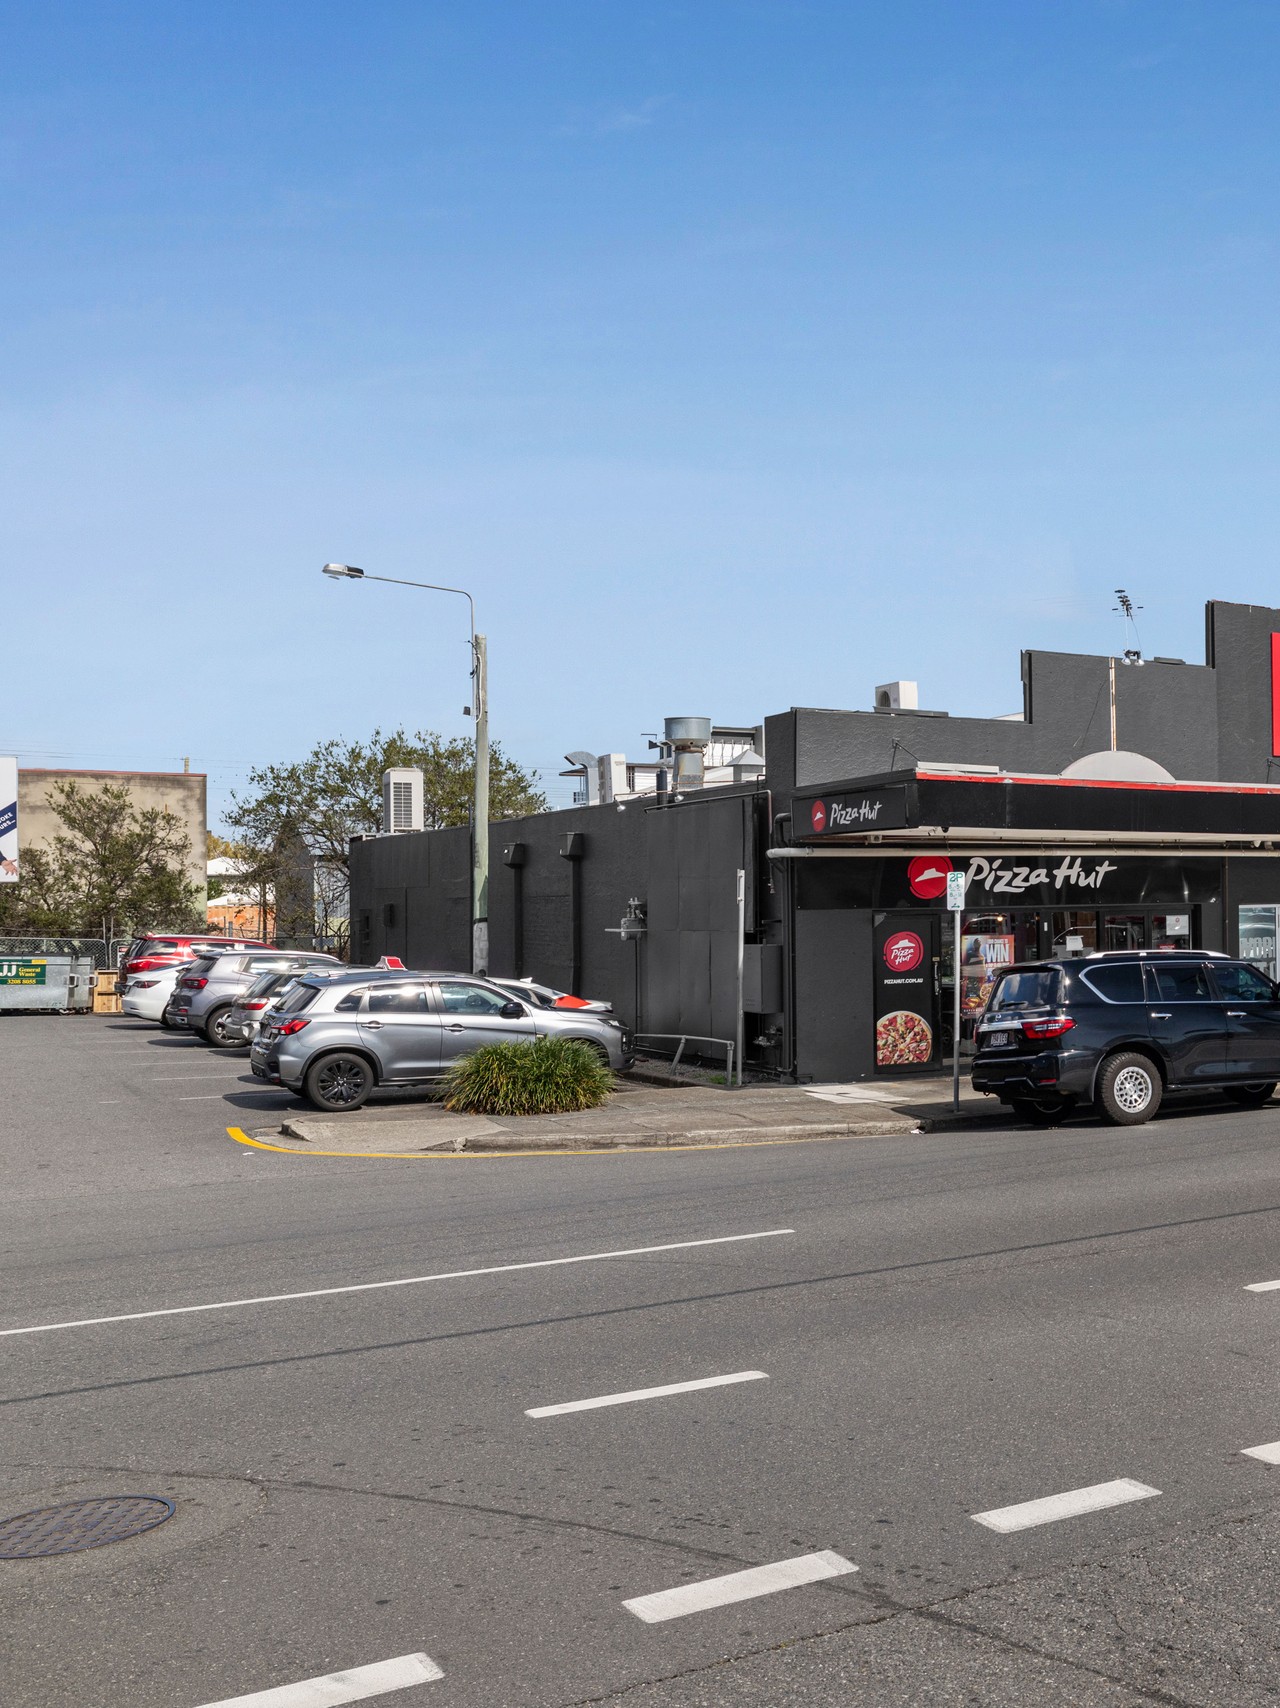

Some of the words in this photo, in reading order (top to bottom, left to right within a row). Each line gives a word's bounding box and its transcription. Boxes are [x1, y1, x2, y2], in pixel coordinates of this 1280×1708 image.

[829, 803, 859, 828] Pizza
[859, 800, 883, 822] Hut
[950, 873, 963, 882] 2P
[964, 857, 1050, 894] Pizza
[1052, 855, 1118, 890] Hut
[891, 948, 914, 960] Pizza
[895, 954, 913, 965] Hut
[986, 944, 1009, 962] WIN
